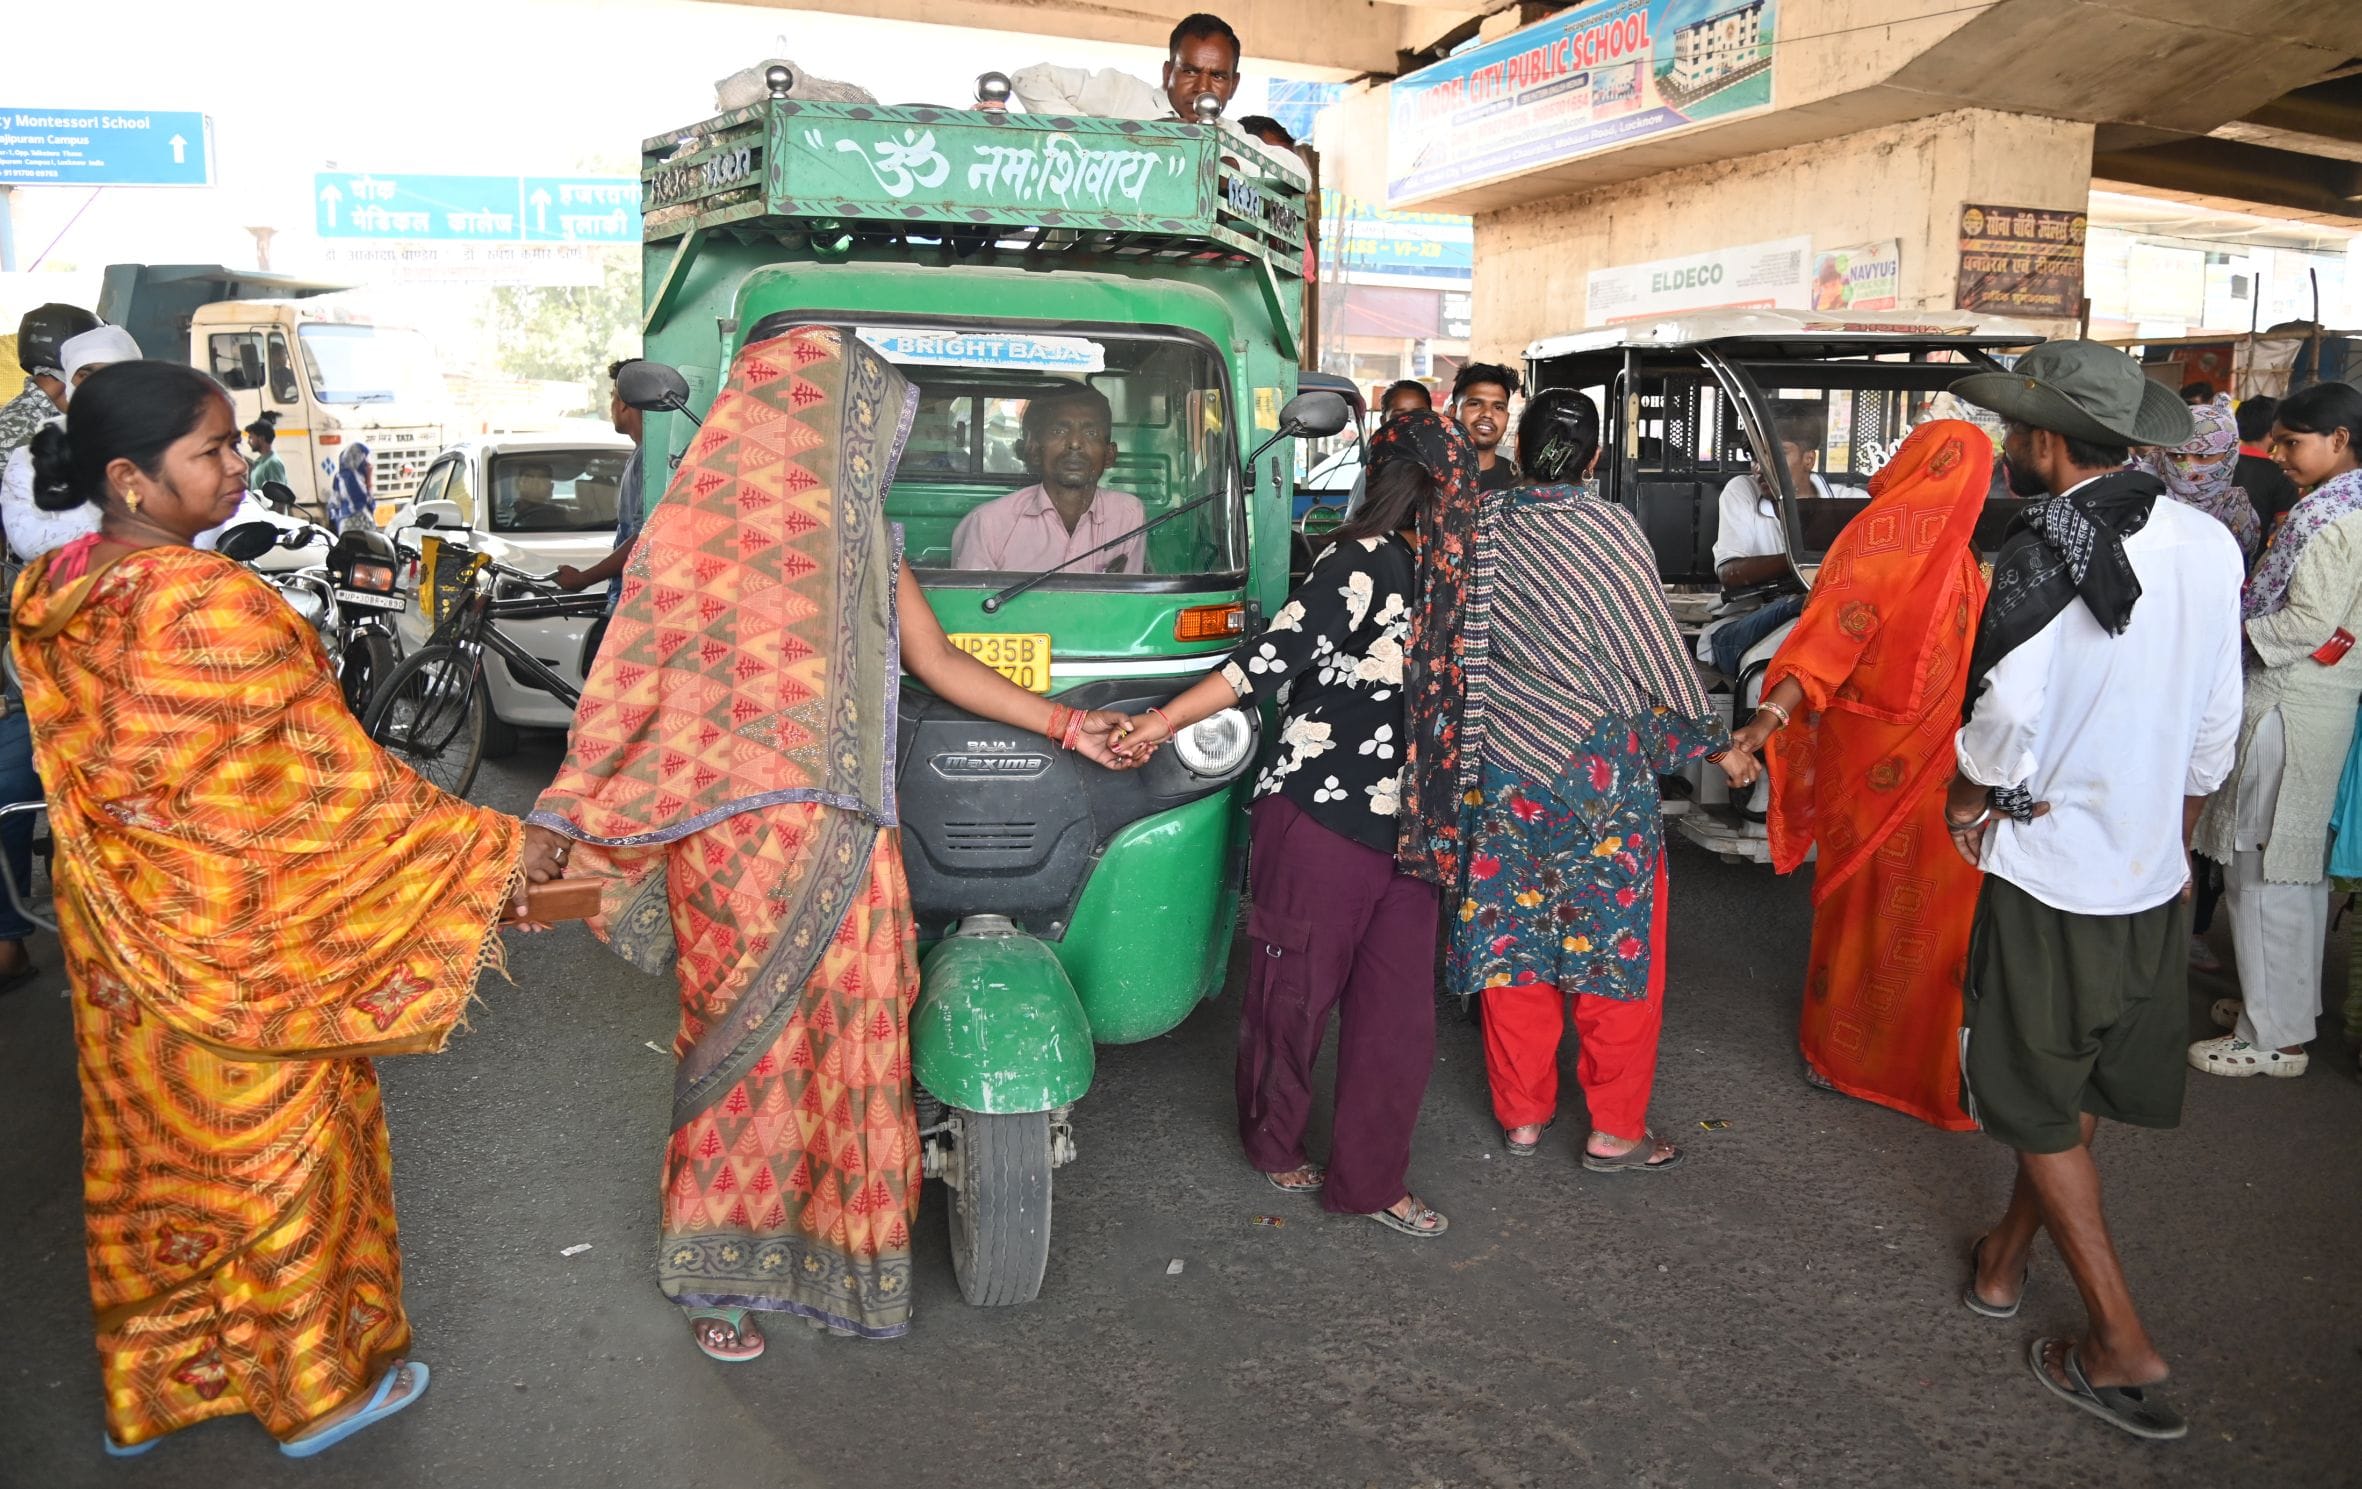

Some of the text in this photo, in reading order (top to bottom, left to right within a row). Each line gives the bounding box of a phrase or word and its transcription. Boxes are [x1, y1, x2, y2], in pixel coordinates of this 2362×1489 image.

[1417, 75, 1466, 122] MODEL
[1469, 60, 1506, 102] CITY
[1507, 37, 1570, 92] PUBLIC
[1573, 9, 1651, 70] SCHOOL
[16, 114, 99, 129] Montessori
[102, 116, 150, 129] School
[1619, 113, 1664, 133] Lucknow
[47, 134, 89, 147] Campus
[1651, 263, 1723, 293] ELDECO
[1850, 260, 1896, 281] NAVYUG
[897, 336, 1004, 357] BRIGHT
[395, 434, 414, 442] TATA
[967, 741, 1016, 751] BAJAJ
